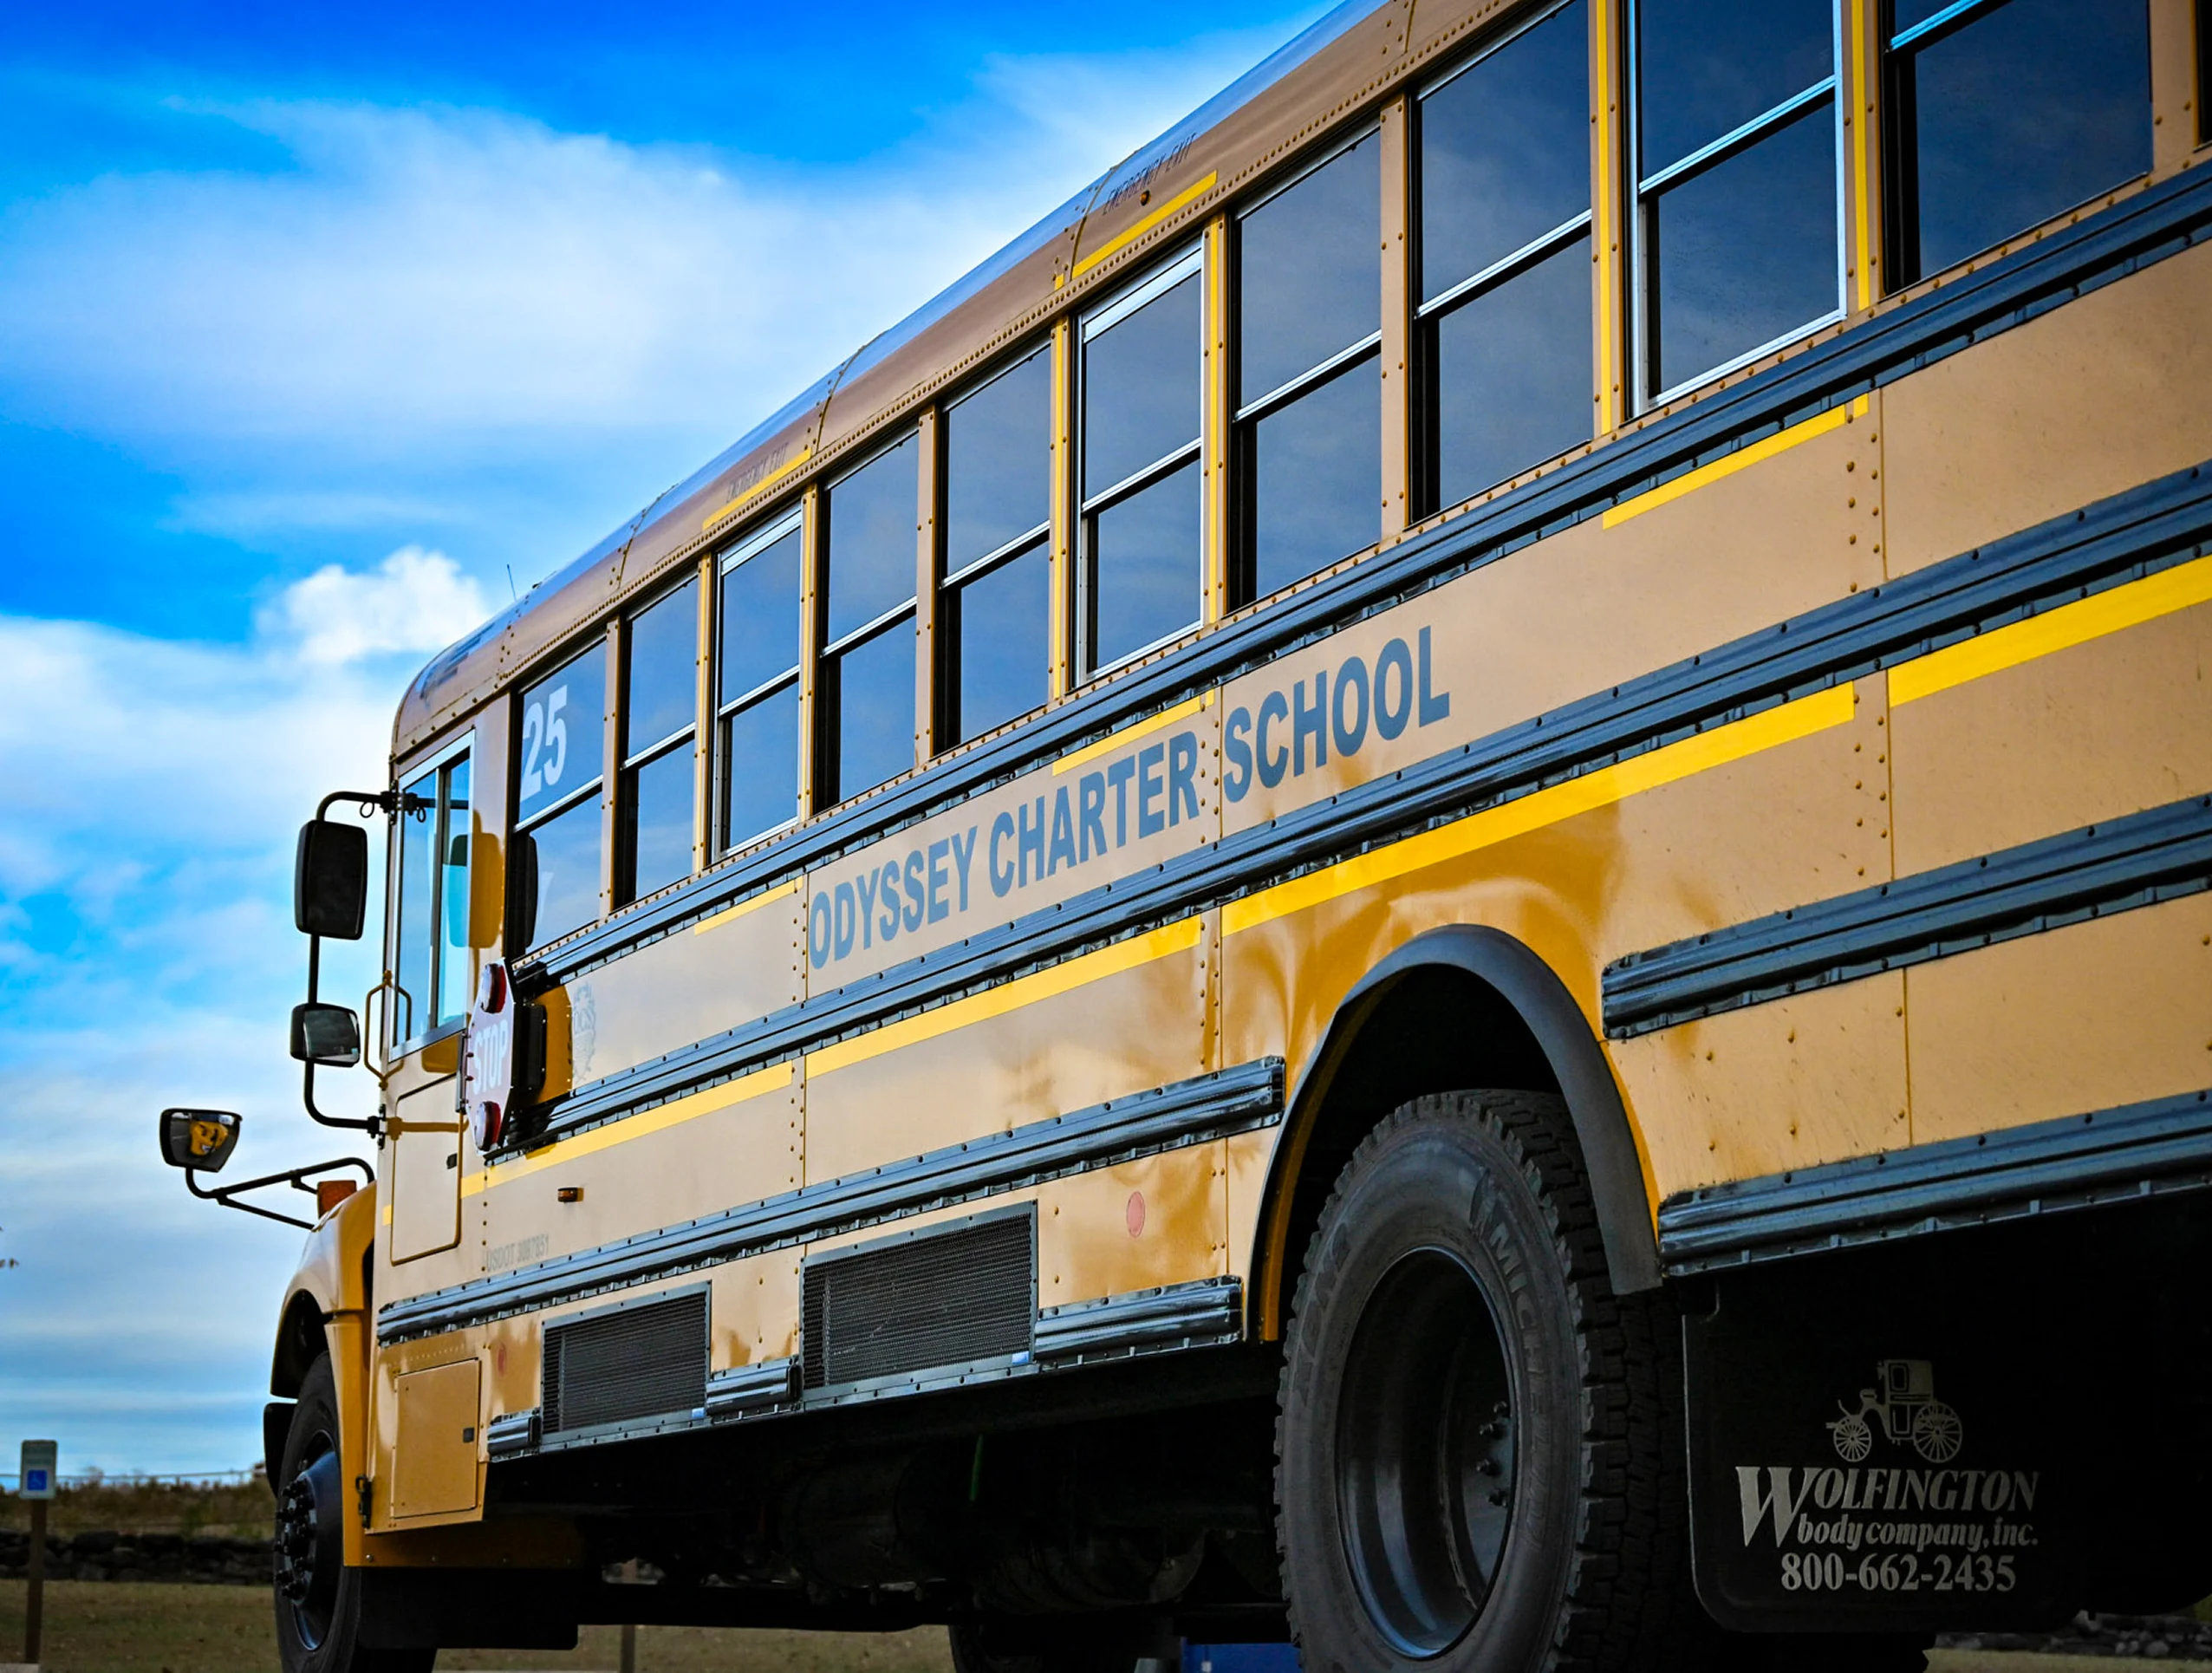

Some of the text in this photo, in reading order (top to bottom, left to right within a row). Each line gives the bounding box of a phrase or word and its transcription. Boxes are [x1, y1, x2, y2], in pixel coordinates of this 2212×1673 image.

[520, 683, 568, 802] 25
[809, 624, 1451, 969] ODYSSEY CHARTER SCHOOL
[472, 1019, 509, 1096] STOP
[485, 1242, 516, 1273] USDOT
[1734, 1466, 2040, 1548] WOLFINGTON
[1797, 1513, 1864, 1551] body
[1780, 1553, 2017, 1592] 800-662-2435
